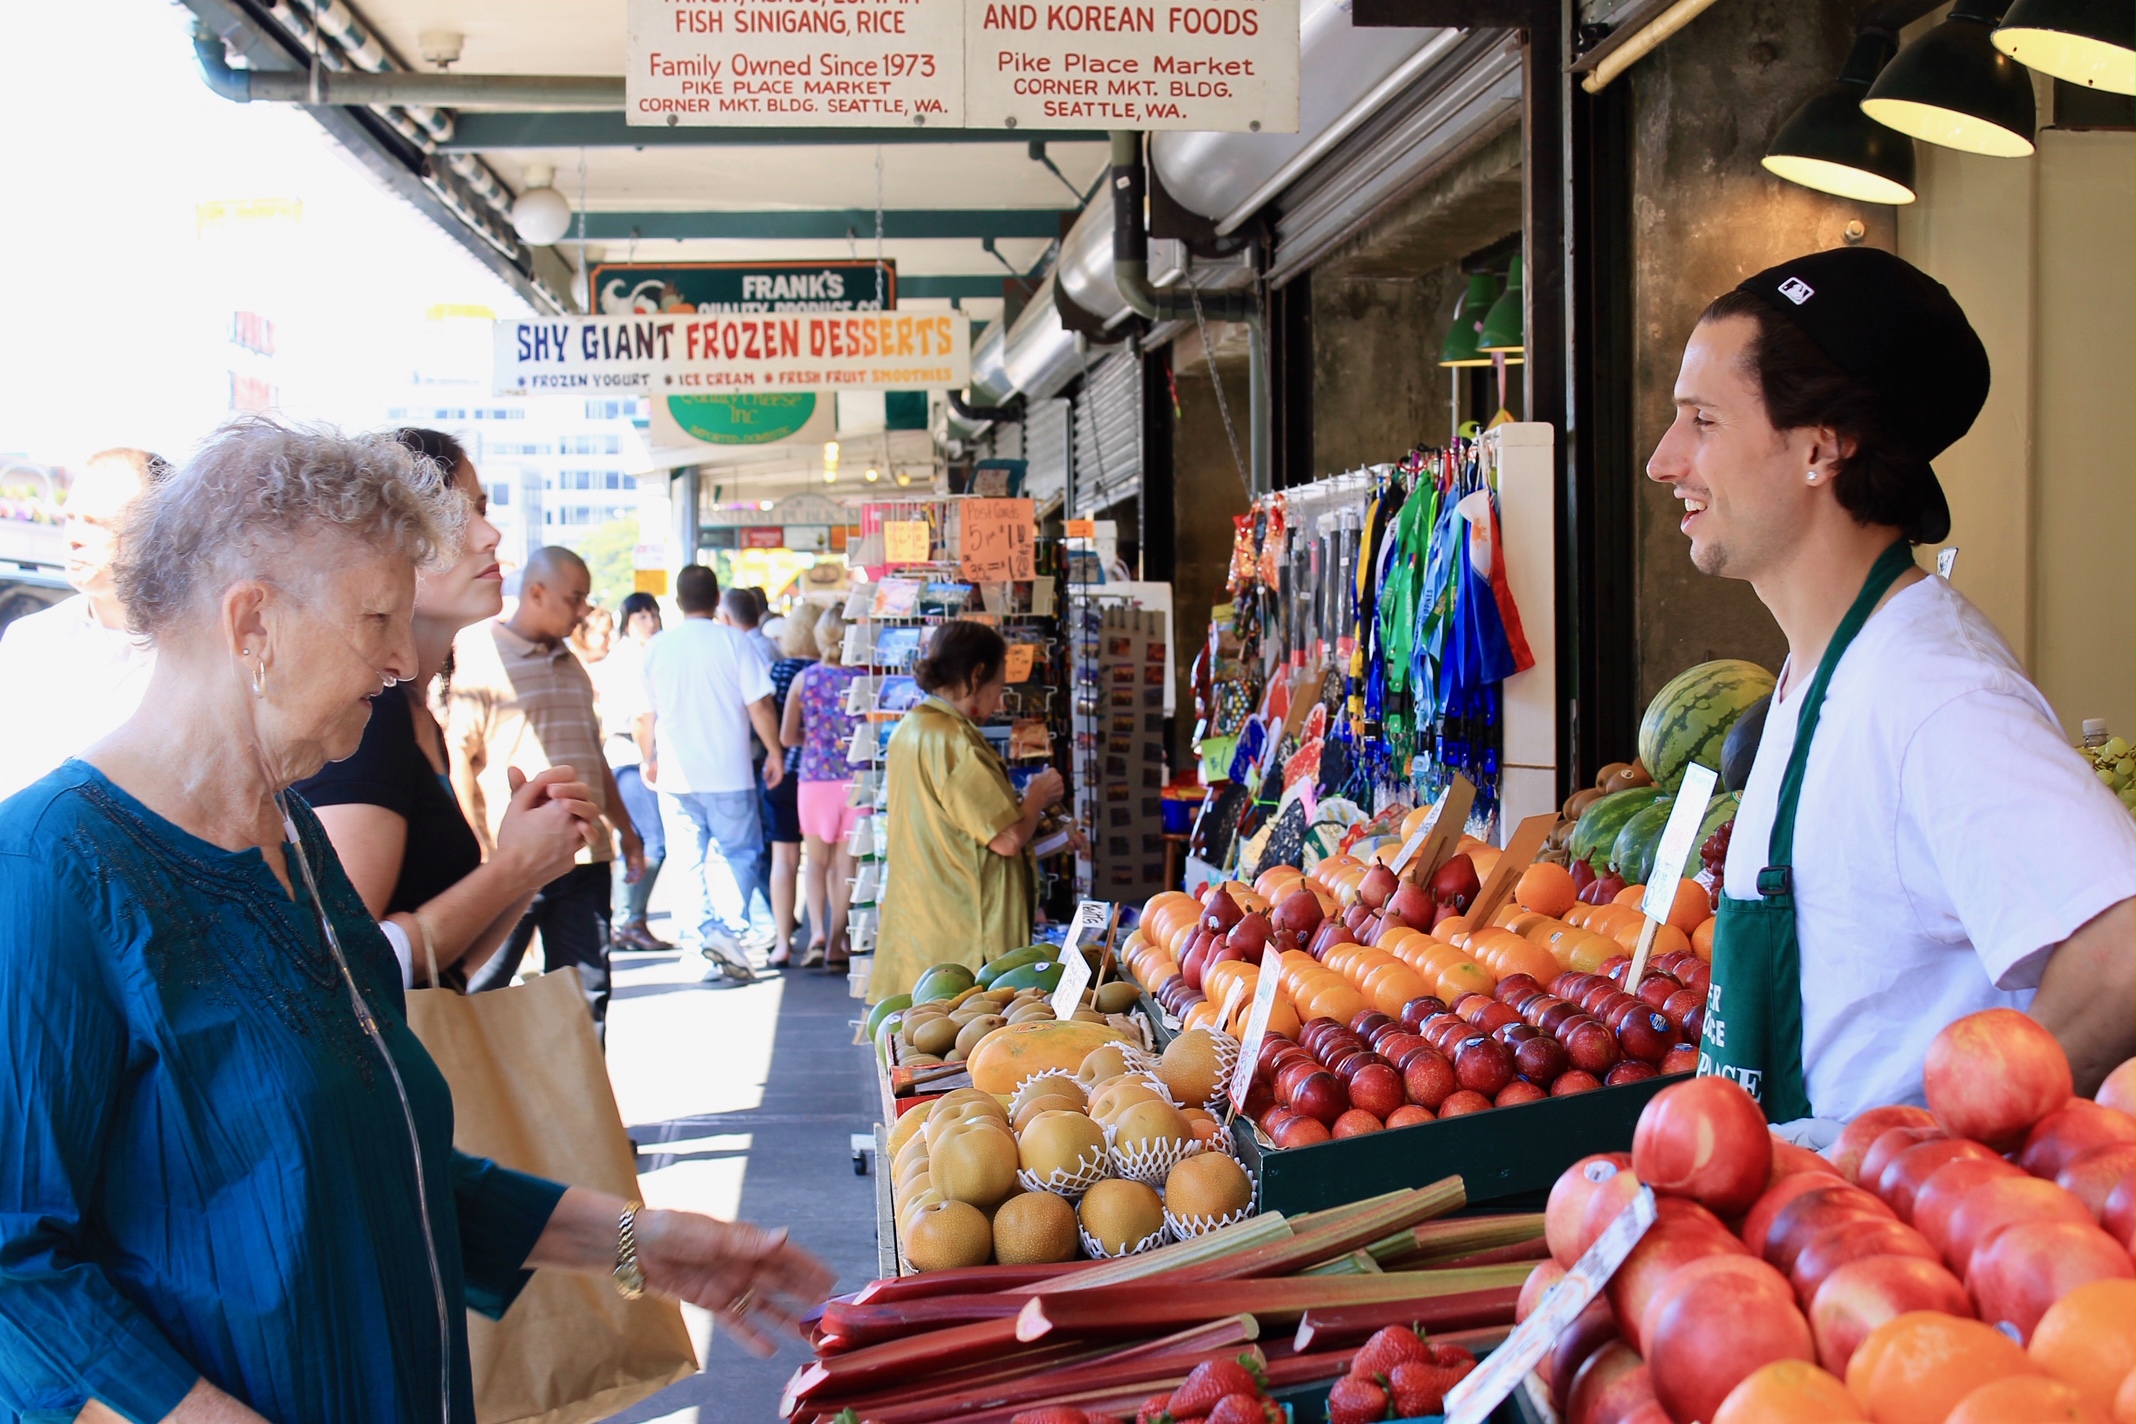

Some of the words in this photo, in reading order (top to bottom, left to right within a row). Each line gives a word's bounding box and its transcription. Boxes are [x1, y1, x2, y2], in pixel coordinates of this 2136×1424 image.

[676, 10, 723, 32] FISH
[736, 10, 851, 36] SINIGANG,
[858, 11, 906, 33] RICE
[984, 4, 1037, 30] AND
[1048, 5, 1154, 32] KOREAN
[1169, 7, 1258, 36] FOODS
[650, 54, 721, 79] Family
[732, 54, 811, 76] Owned
[821, 54, 877, 76] Since
[882, 54, 936, 77] 1973
[998, 51, 1050, 72] Pike
[1065, 54, 1138, 73] Place
[1154, 56, 1255, 75] Market
[682, 81, 723, 94] PIKE
[734, 81, 793, 94] PLACE
[804, 81, 891, 94] MARKET
[1014, 79, 1098, 95] CORNER
[1108, 80, 1158, 97] MKT.
[1170, 81, 1232, 97] BLDG.
[640, 98, 709, 112] CORNER
[720, 99, 761, 112] MKT.
[768, 99, 818, 112] BLDG.
[828, 99, 908, 115] SEATTLE,
[915, 100, 948, 113] WA.
[1044, 101, 1140, 121] SEATTLE,
[1146, 103, 1187, 118] WA.
[742, 271, 844, 300] FRANK'S
[518, 324, 568, 362] SHY
[582, 322, 674, 361] GIANT
[687, 319, 798, 360] FROZEN
[810, 317, 953, 358] DESSERTS
[533, 374, 587, 387] FROZEN
[593, 374, 650, 386] YOGURT
[679, 374, 700, 386] ICE
[707, 372, 755, 386] CREAM
[779, 371, 821, 385] FRESH
[826, 371, 866, 383] FRUIT
[872, 368, 952, 383] SMOOTHIES
[969, 523, 983, 551] 5
